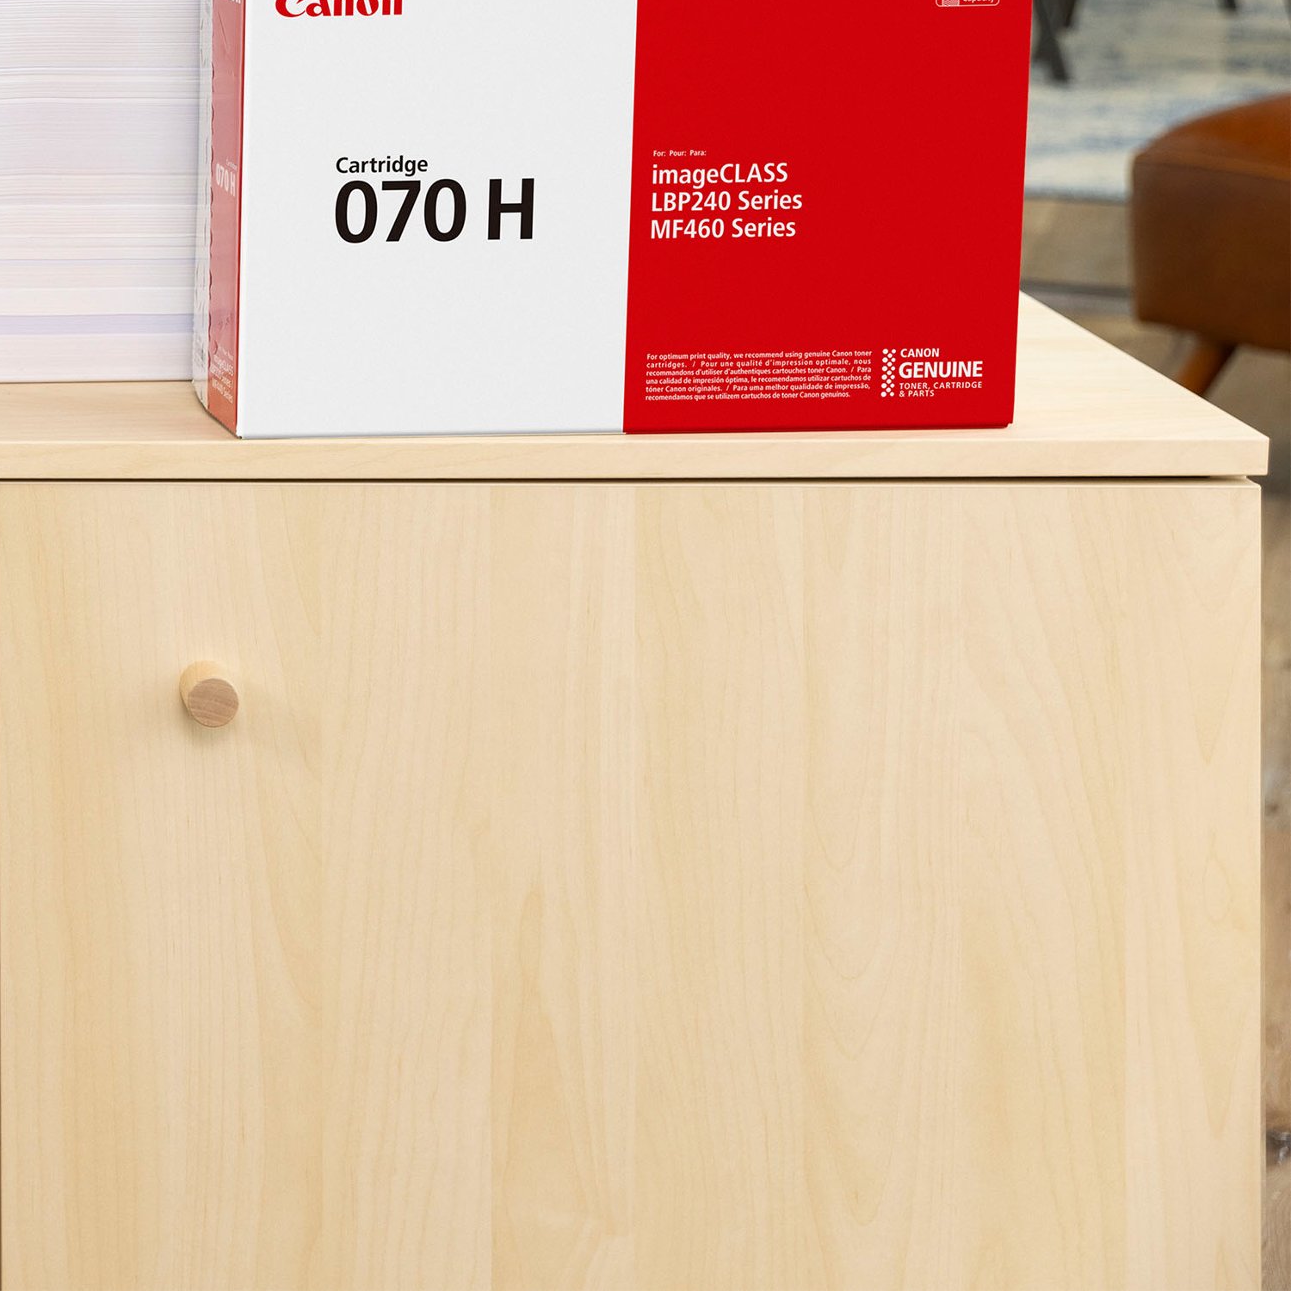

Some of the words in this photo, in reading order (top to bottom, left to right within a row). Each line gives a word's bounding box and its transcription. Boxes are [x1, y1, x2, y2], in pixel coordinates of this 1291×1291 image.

[336, 155, 428, 178] Cartridge
[216, 163, 230, 192] 070
[653, 163, 787, 190] imageCLASS
[652, 191, 730, 211] LBP240
[739, 189, 802, 210] Series
[335, 179, 466, 243] 070
[488, 178, 534, 240] H
[651, 219, 724, 239] MF460
[732, 217, 795, 237] Series
[659, 352, 688, 361] optimum
[690, 352, 706, 360] print
[707, 352, 732, 360] quality,
[785, 351, 802, 359] using
[804, 350, 830, 358] genuine
[901, 348, 939, 357] CANON
[646, 361, 687, 369] cartridges.
[815, 358, 850, 367] optimale,
[899, 361, 983, 378] GENUINE
[688, 385, 722, 393] originales.
[790, 383, 823, 391] qualidade
[900, 382, 930, 390] TONER,
[934, 381, 982, 389] CARTRIDGE
